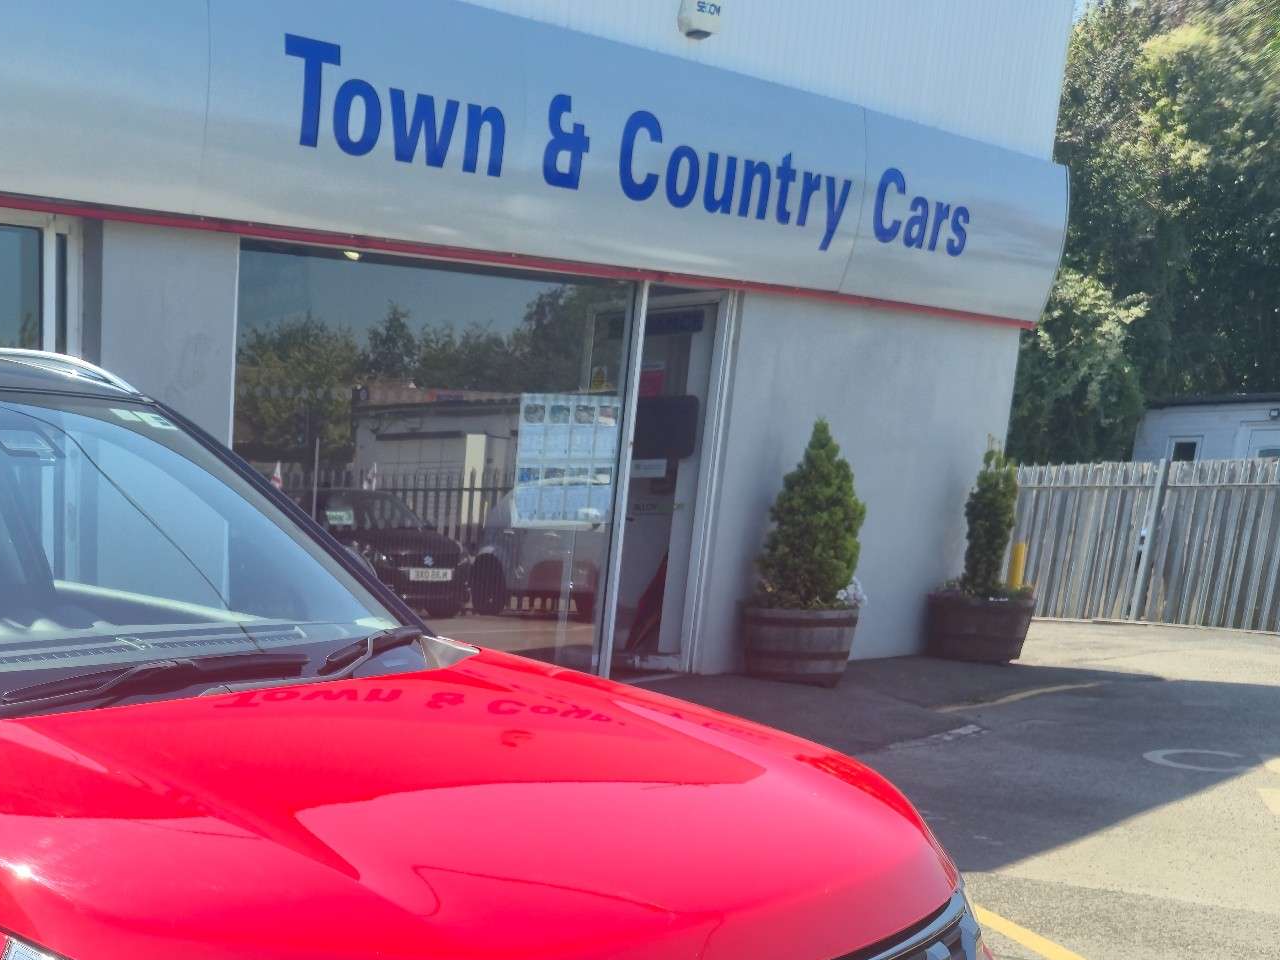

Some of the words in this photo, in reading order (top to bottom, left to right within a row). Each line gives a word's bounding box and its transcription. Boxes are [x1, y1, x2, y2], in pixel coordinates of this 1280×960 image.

[285, 33, 506, 177] Town
[542, 94, 590, 190] &
[620, 110, 852, 251] Country
[872, 167, 970, 257] Cars
